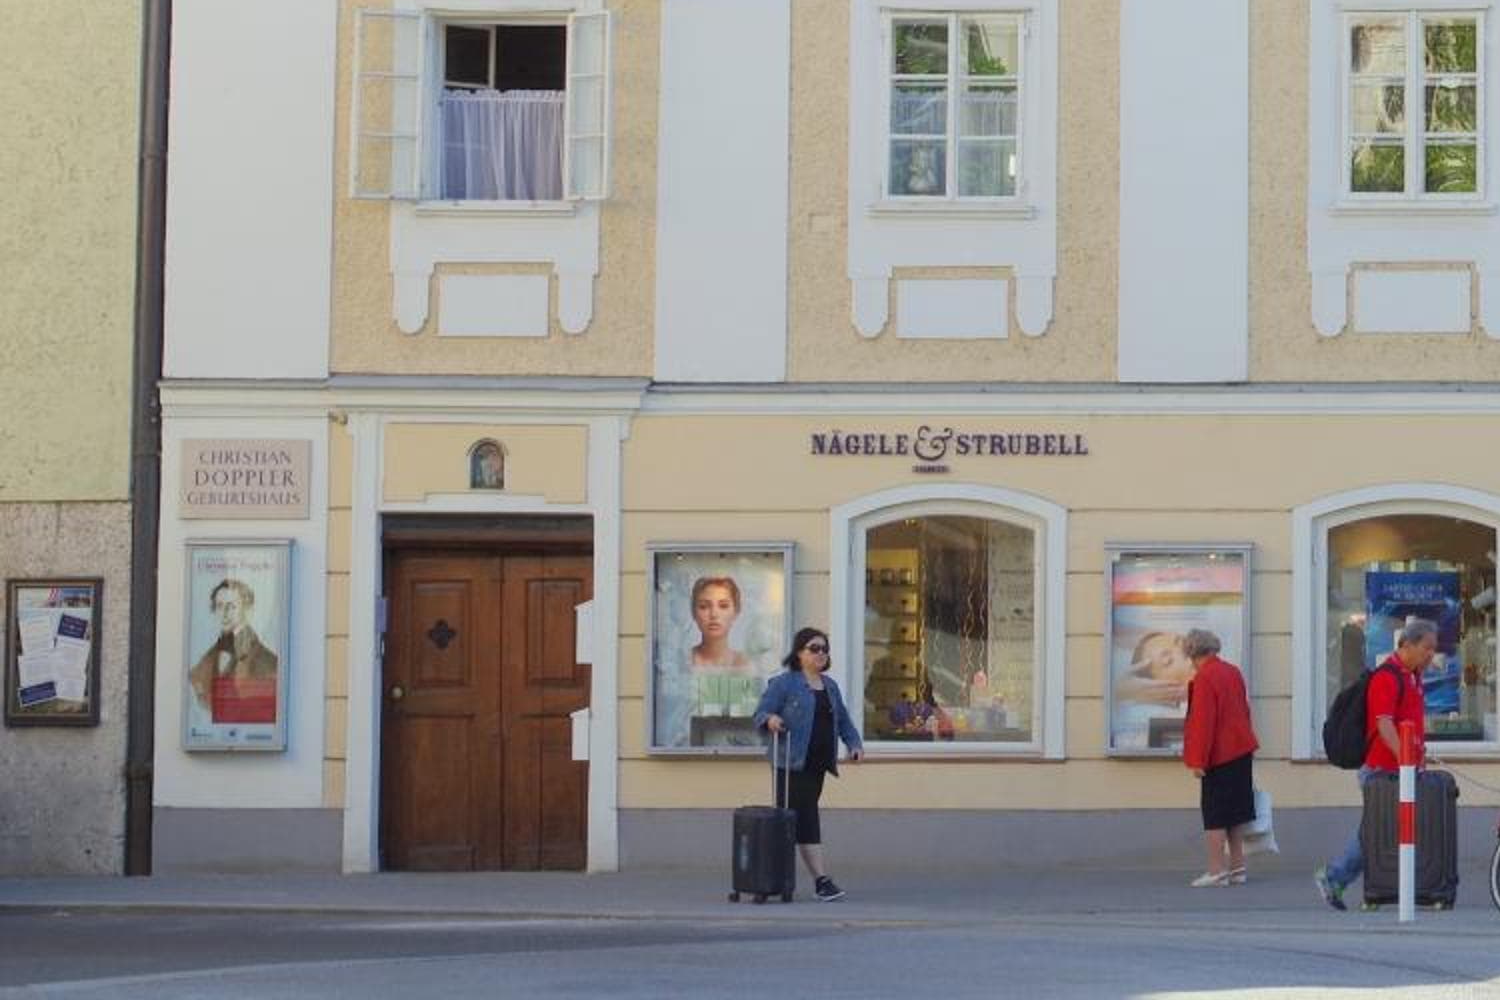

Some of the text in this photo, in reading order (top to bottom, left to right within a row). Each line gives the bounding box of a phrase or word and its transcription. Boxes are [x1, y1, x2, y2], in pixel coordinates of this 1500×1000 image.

[811, 430, 908, 455] NÄGELE
[955, 433, 1089, 455] STRUBELL
[199, 450, 292, 465] CHRISTIAN
[193, 469, 296, 487] DOPPLER
[186, 490, 302, 505] GEBURTSHAUS
